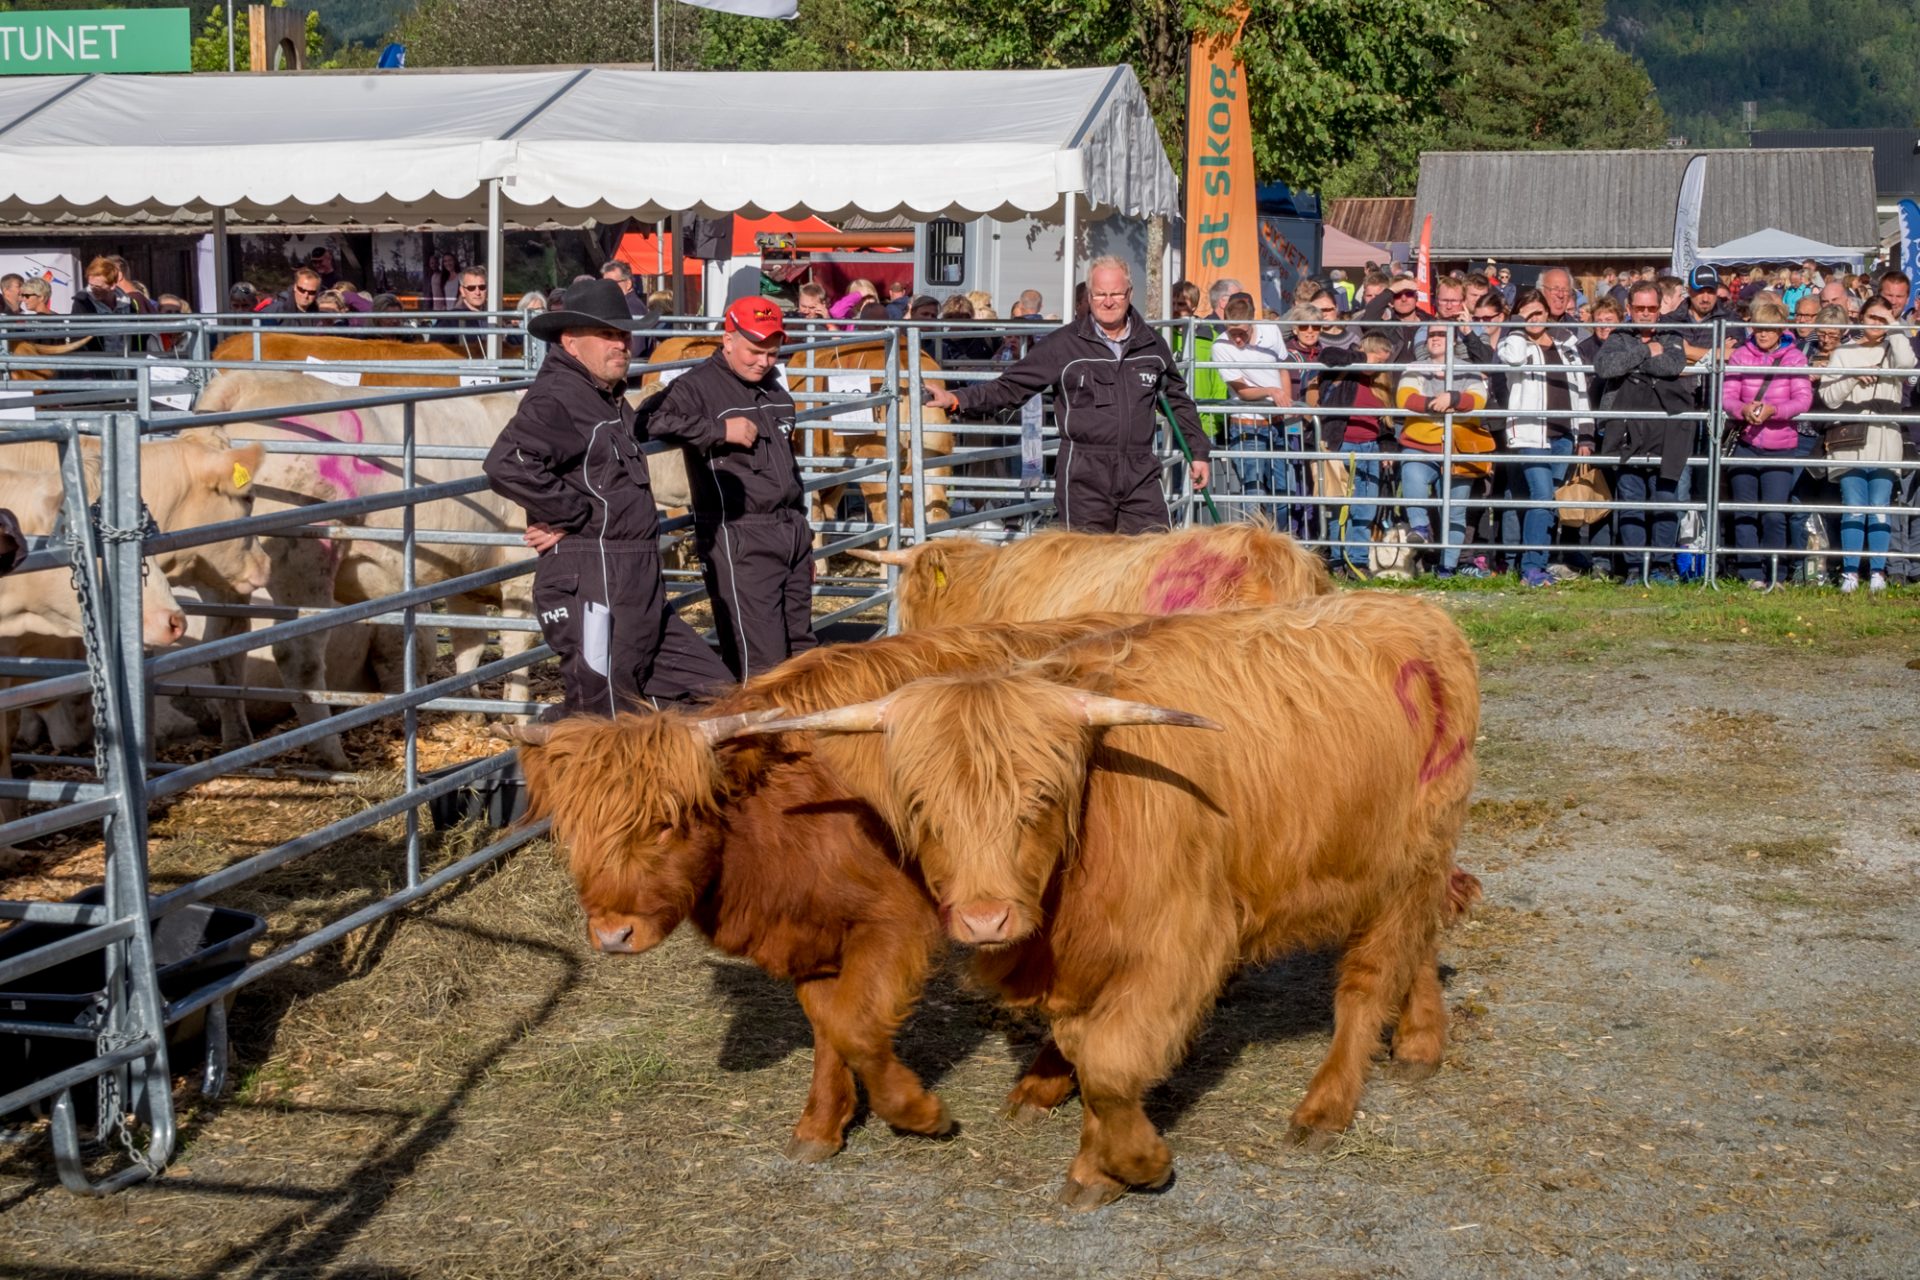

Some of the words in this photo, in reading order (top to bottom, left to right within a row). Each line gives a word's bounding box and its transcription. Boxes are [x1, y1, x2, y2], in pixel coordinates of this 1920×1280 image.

[0, 24, 126, 61] TUNET
[1199, 63, 1237, 196] skog
[1199, 212, 1230, 268] at
